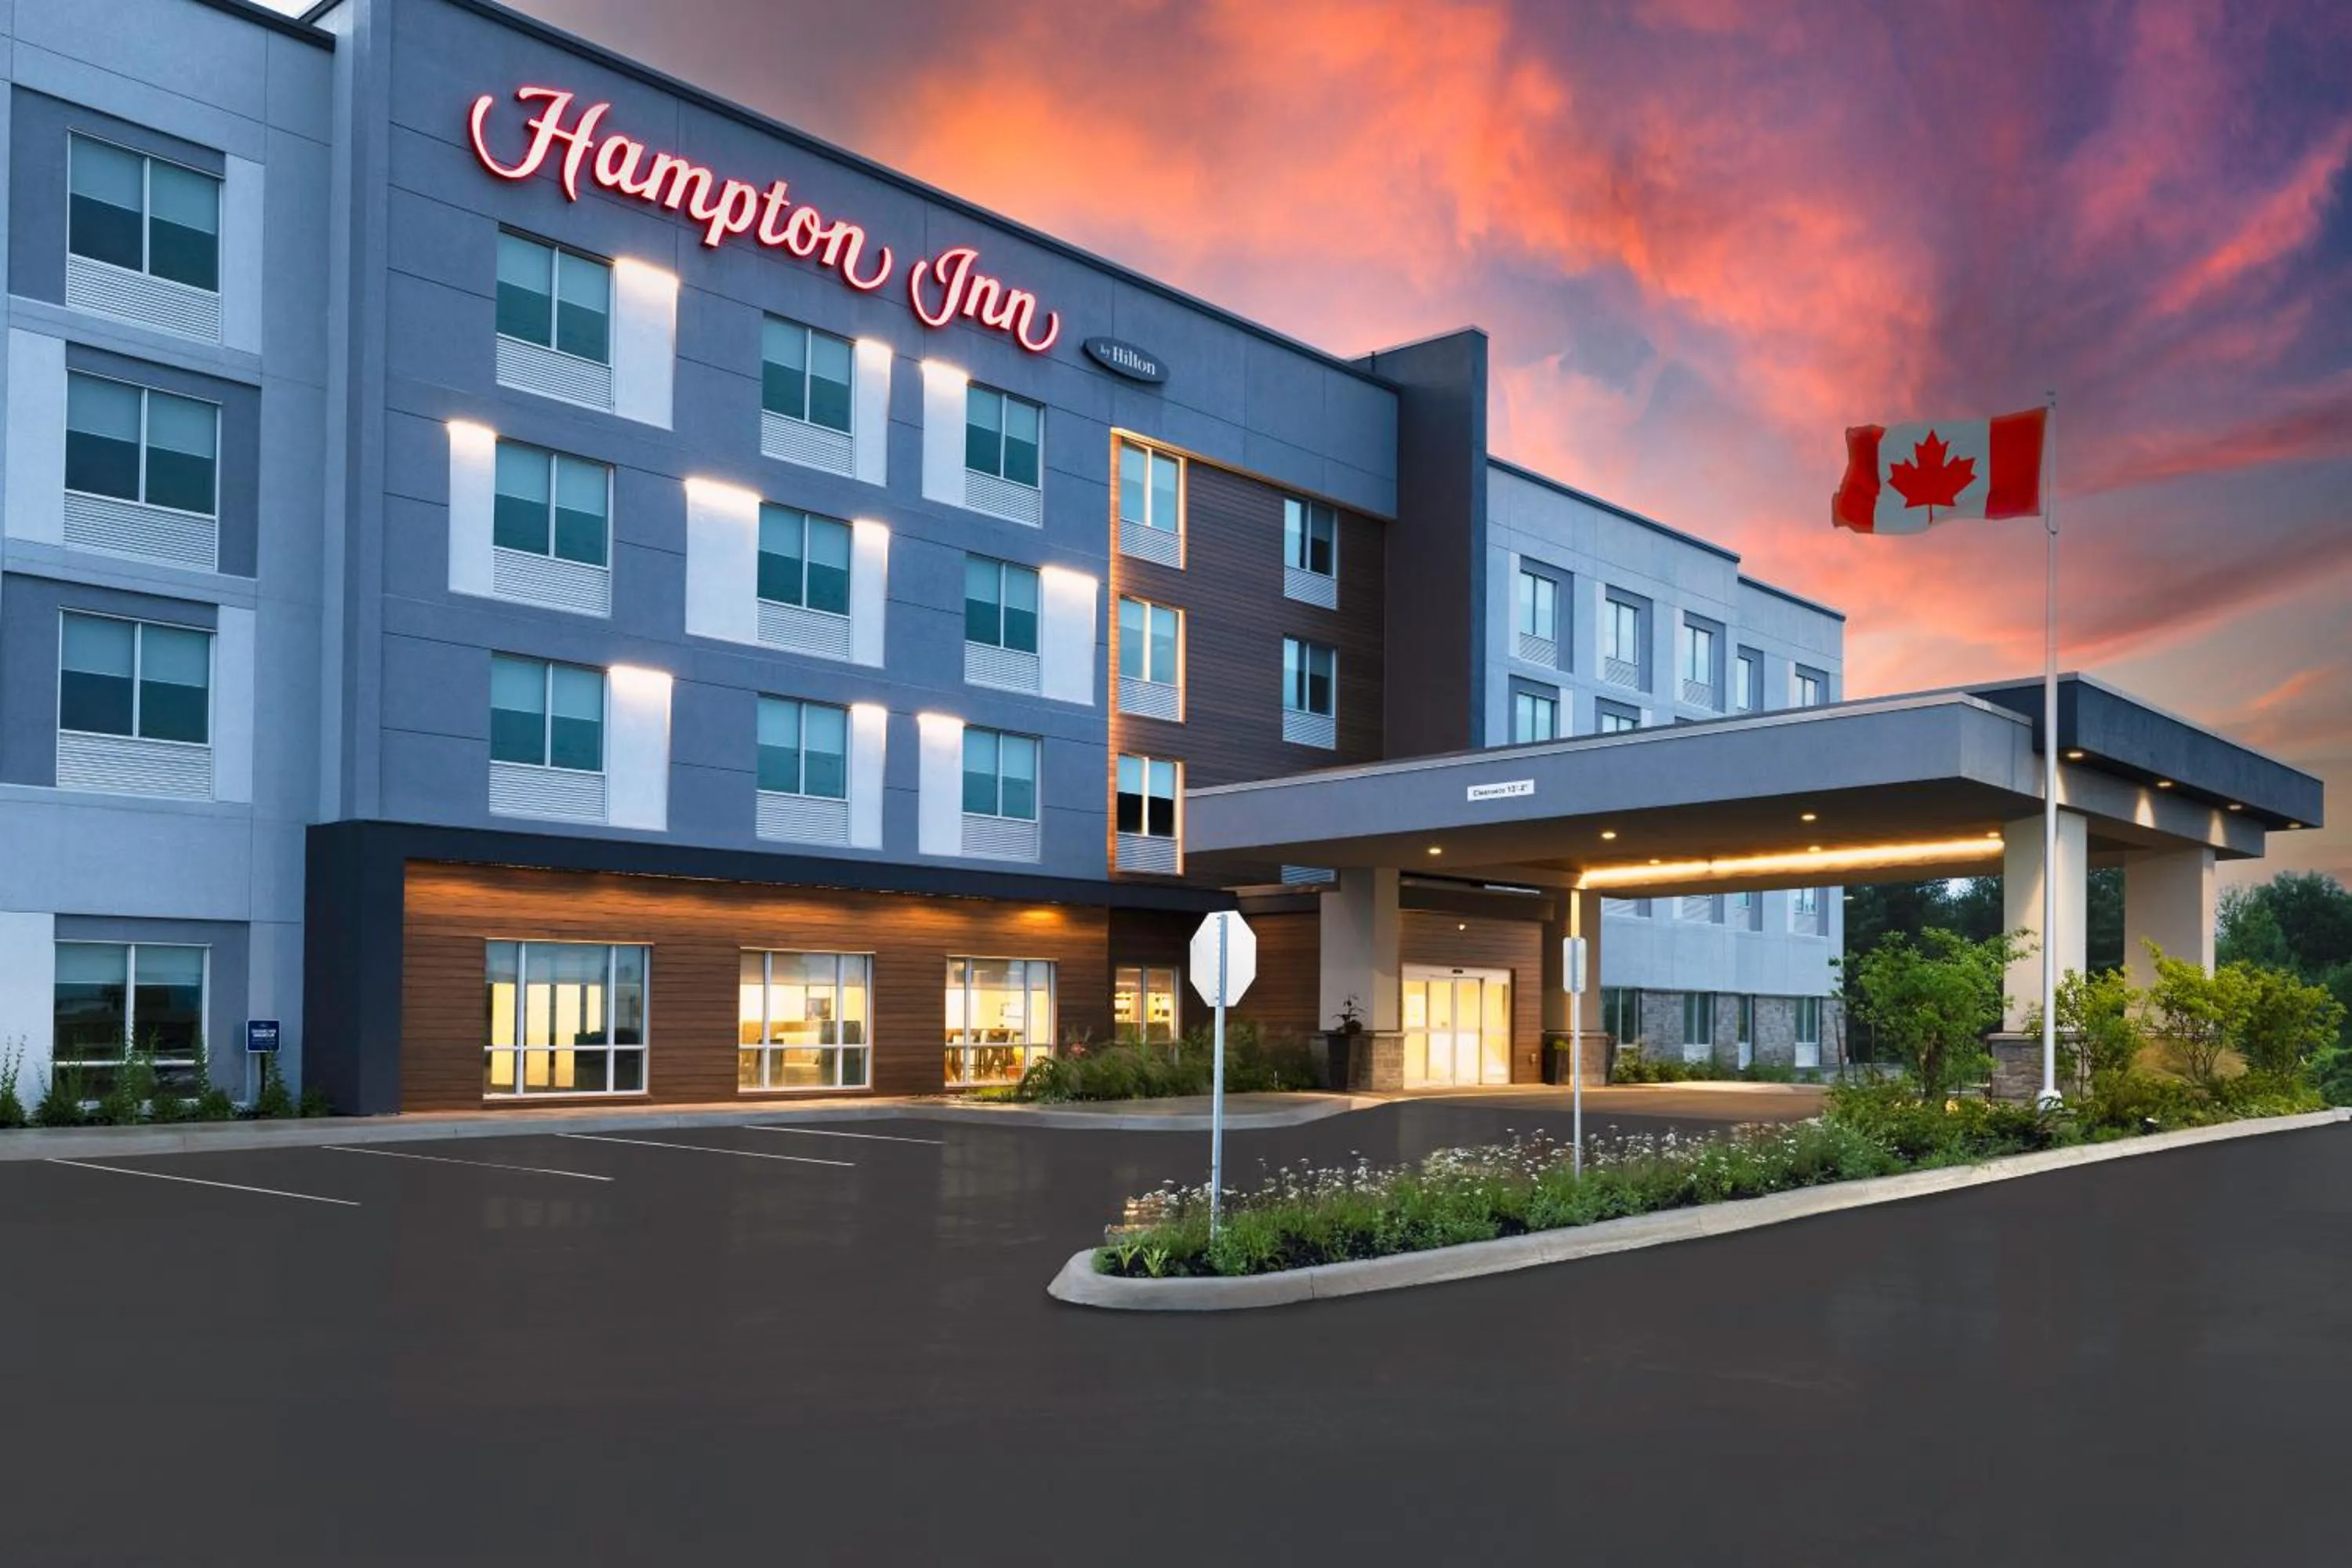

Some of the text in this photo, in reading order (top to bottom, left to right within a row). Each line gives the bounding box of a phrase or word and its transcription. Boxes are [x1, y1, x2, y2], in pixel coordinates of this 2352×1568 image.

[470, 85, 1059, 352] Hampton Inn
[1113, 346, 1156, 376] Hilton
